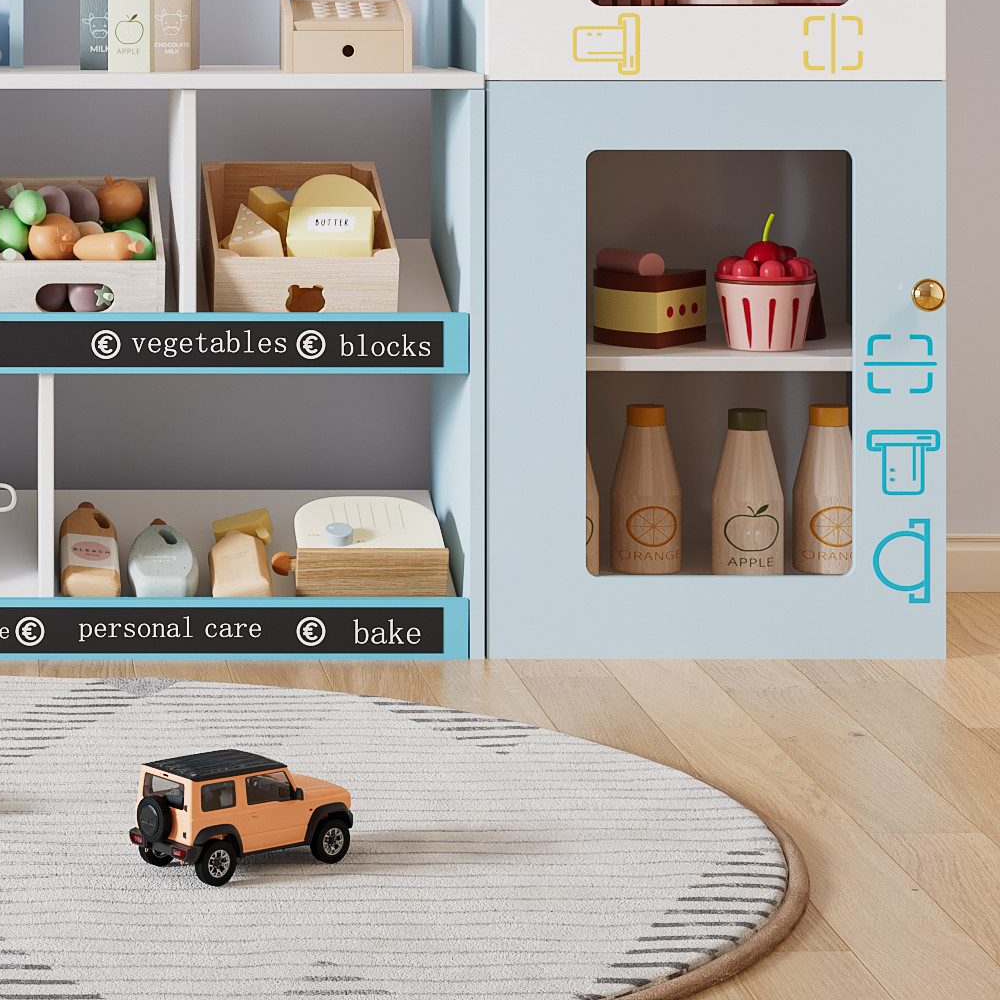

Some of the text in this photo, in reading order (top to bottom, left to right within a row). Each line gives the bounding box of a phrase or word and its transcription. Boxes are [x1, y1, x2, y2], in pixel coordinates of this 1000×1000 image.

[315, 218, 349, 227] BUTTER
[131, 329, 287, 358] vegetables
[340, 333, 431, 357] blocks
[617, 549, 680, 561] ORANGE
[727, 556, 774, 568] APPLE
[78, 615, 194, 642] personal
[204, 622, 262, 638] care
[352, 618, 421, 645] bake
